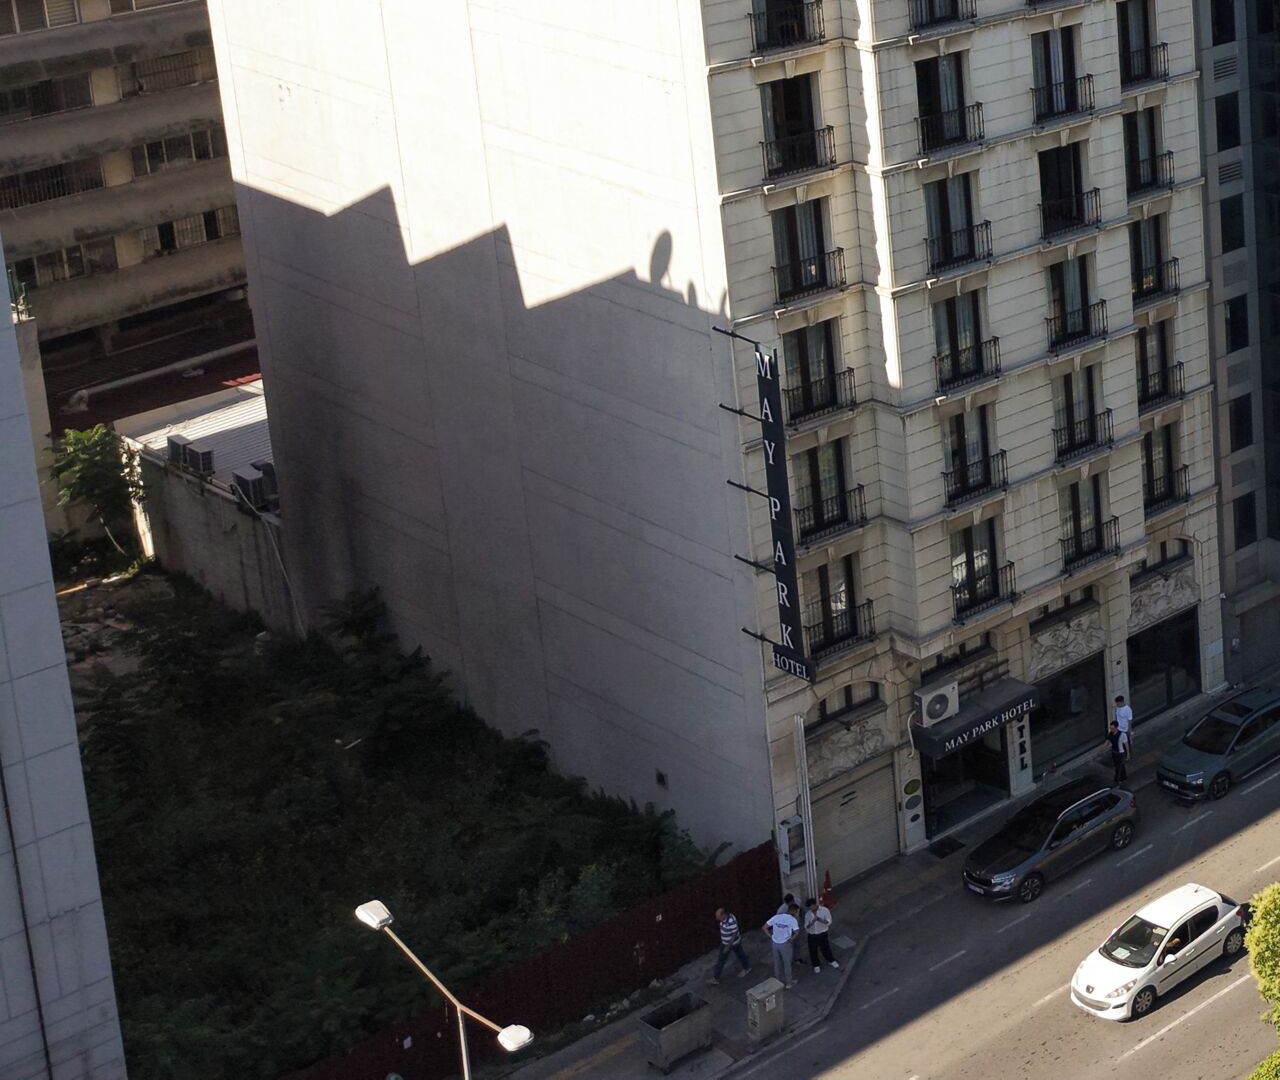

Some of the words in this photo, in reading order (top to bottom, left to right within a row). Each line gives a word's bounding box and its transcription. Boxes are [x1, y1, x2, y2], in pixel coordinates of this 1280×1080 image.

[773, 651, 811, 681] HOTEL
[945, 730, 970, 752] MAY
[972, 715, 999, 738] PARK
[1001, 698, 1036, 723] HOTEL
